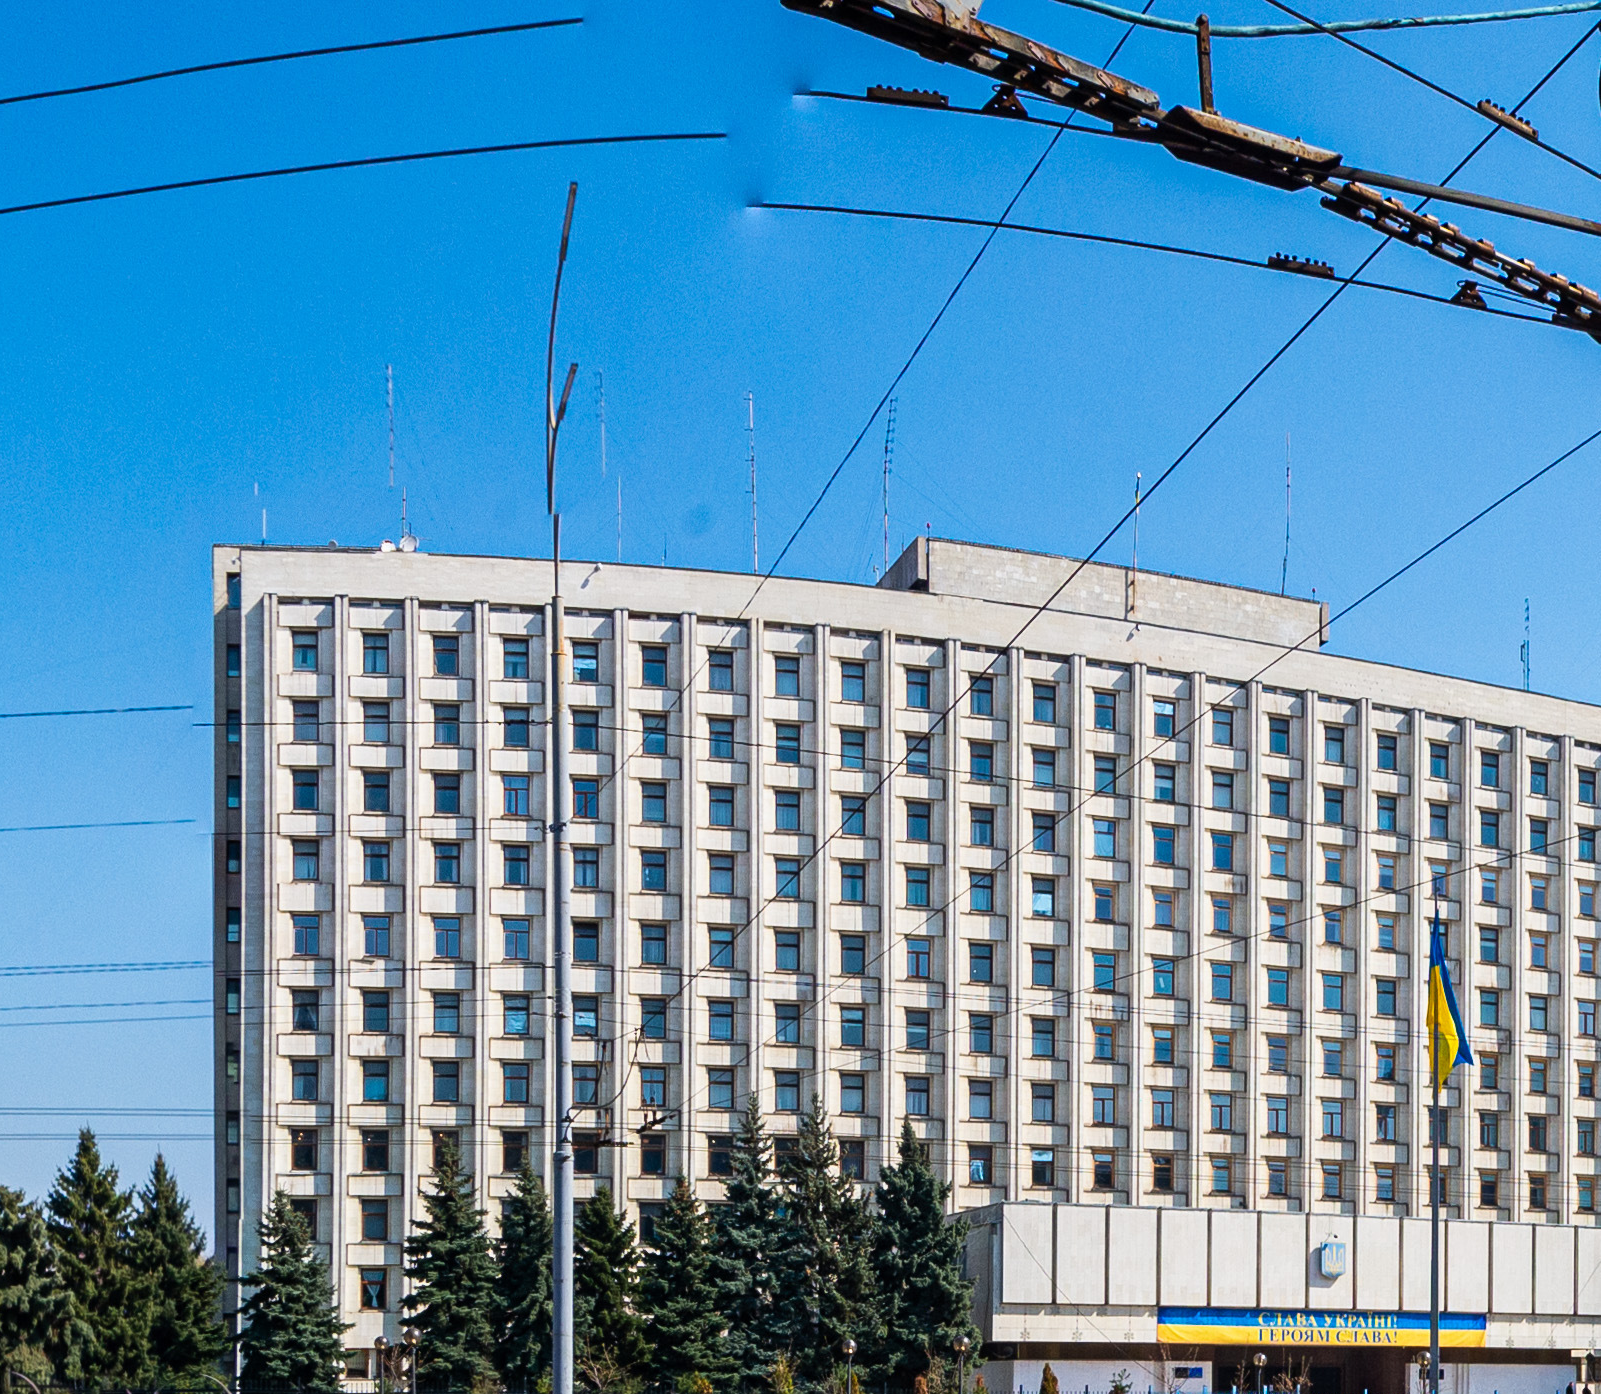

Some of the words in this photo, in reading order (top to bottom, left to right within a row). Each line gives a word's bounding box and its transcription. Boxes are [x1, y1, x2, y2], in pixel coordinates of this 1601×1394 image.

[1258, 1312, 1318, 1327] СЛАВА
[1324, 1312, 1398, 1328] УКРАЇНІ!
[1258, 1329, 1330, 1343] ГЕРОЯМ
[1335, 1330, 1398, 1344] СЛАВА!
